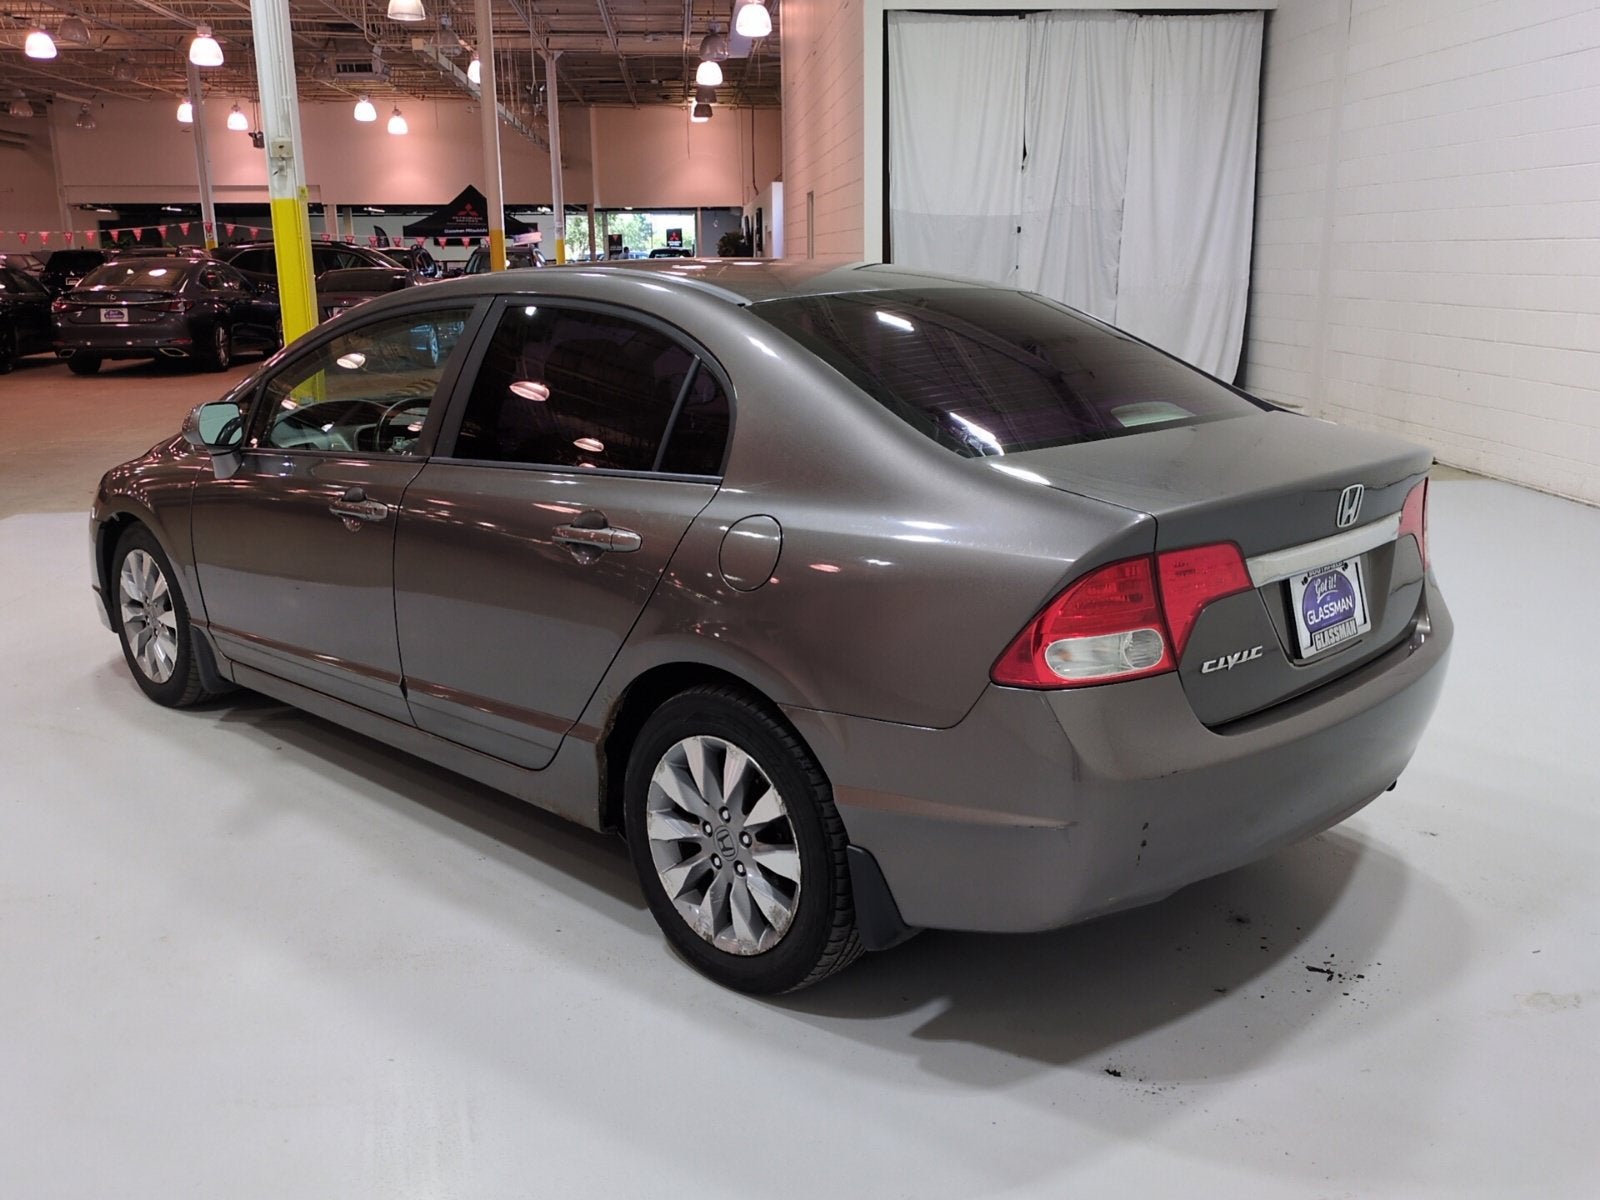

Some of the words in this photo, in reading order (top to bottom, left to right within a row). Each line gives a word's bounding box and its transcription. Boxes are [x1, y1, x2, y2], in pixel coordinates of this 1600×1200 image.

[1314, 576, 1328, 598] Got
[1328, 573, 1337, 590] it!
[1307, 595, 1353, 624] GLASSMAN
[1315, 620, 1357, 650] GLASSMAN
[1202, 645, 1263, 674] CIVIC
